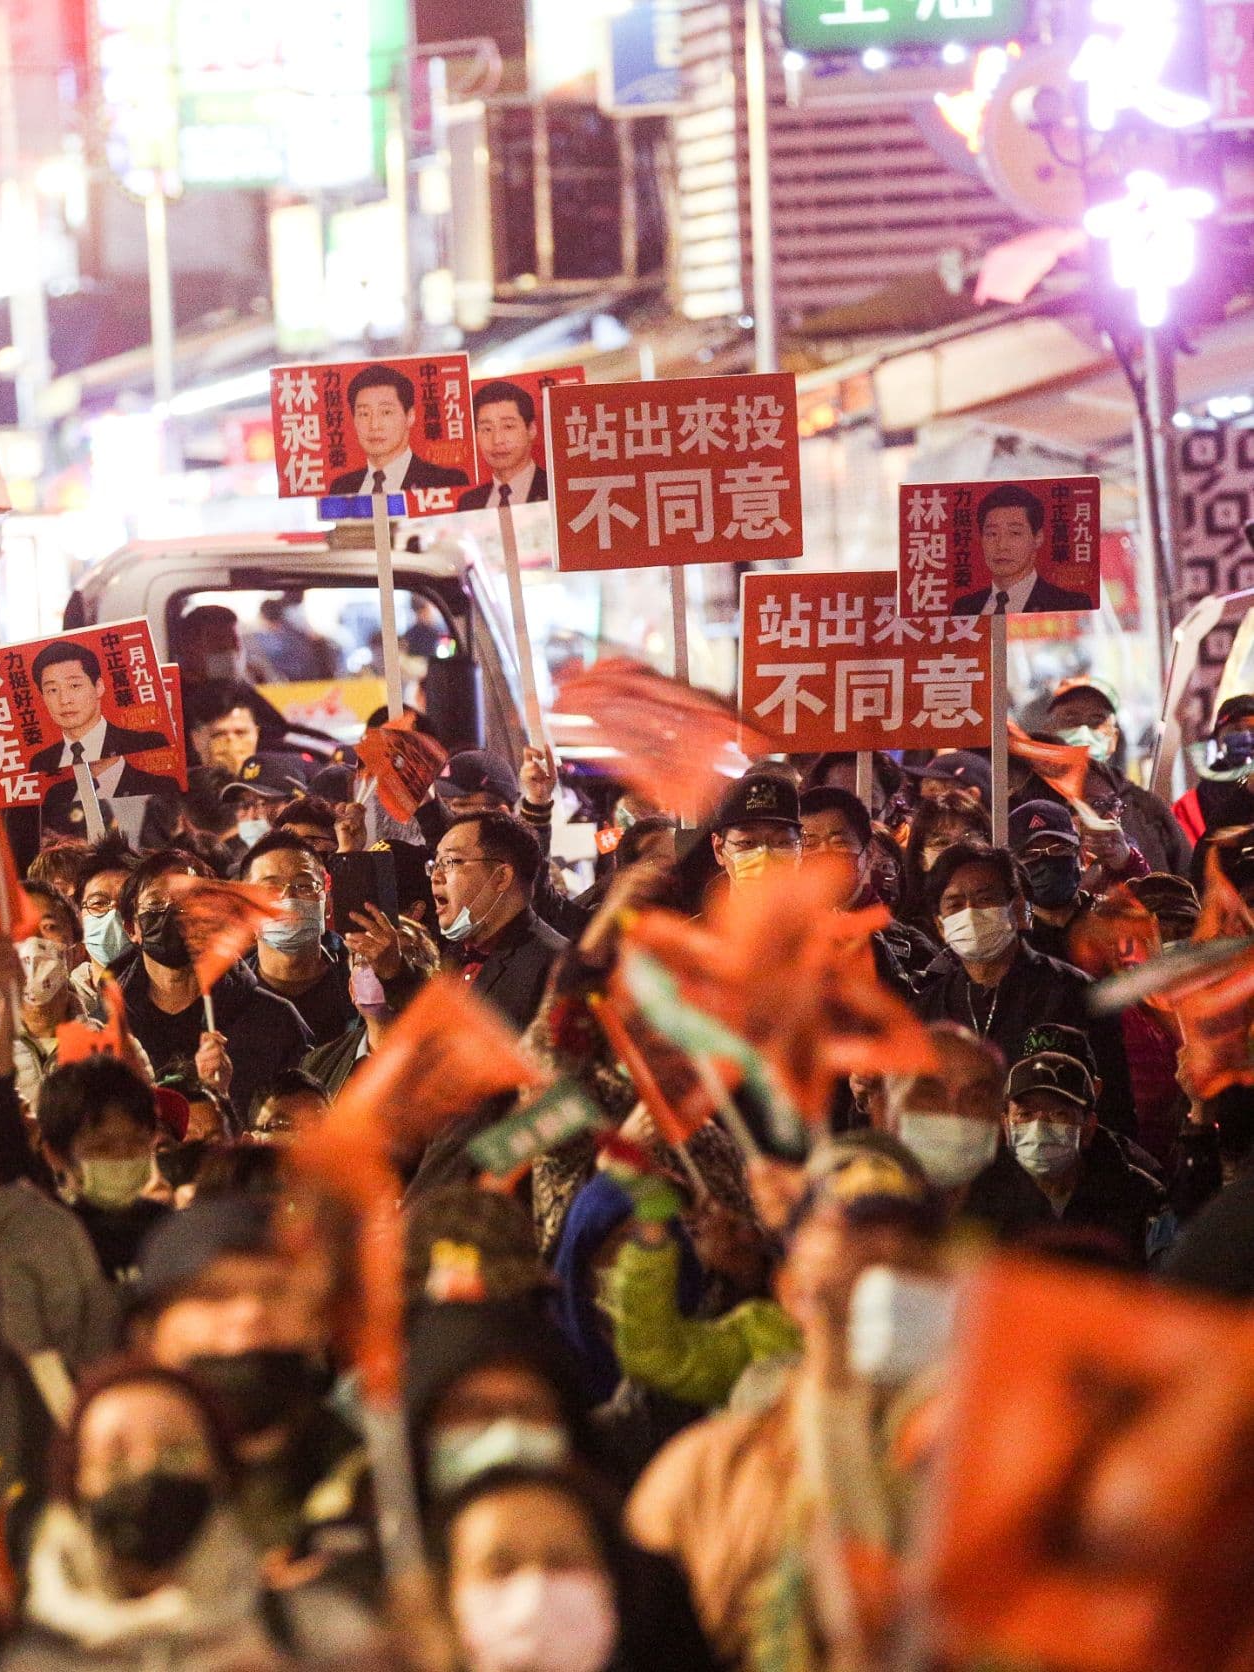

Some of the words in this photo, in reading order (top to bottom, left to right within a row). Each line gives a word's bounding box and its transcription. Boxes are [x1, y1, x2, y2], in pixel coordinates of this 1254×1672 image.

[278, 370, 326, 497] 林昶佐
[441, 366, 465, 440] 一月九日
[564, 394, 786, 462] 站出來投
[567, 461, 793, 550] 不同意
[1072, 487, 1094, 563] 一月九日
[907, 488, 948, 613] 林昶佐
[4, 651, 44, 746] 力挺好立委
[122, 633, 157, 704] 一月九日
[752, 653, 986, 735] 不同意
